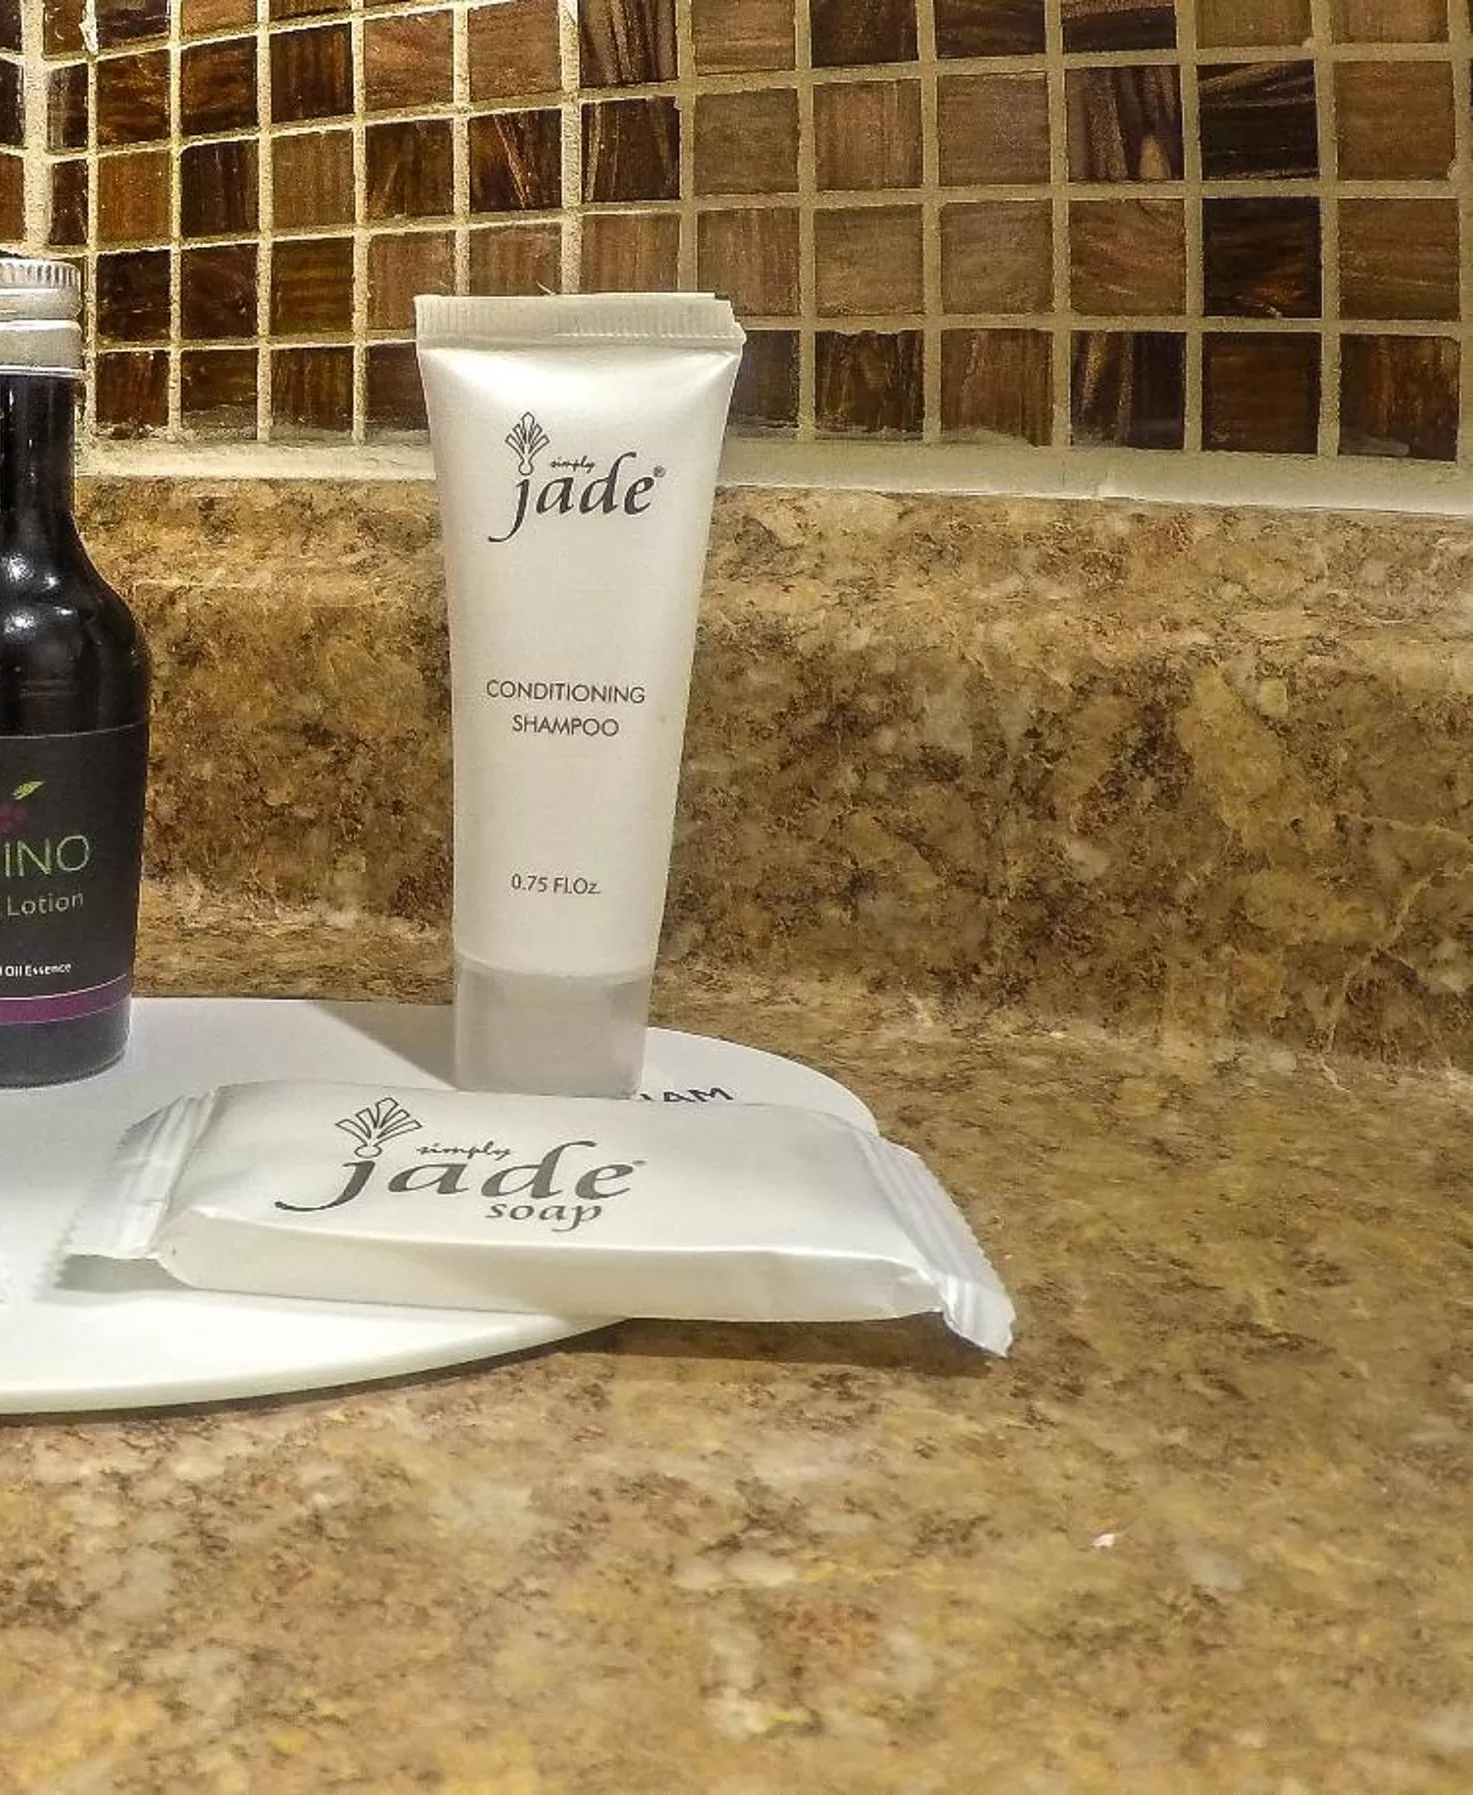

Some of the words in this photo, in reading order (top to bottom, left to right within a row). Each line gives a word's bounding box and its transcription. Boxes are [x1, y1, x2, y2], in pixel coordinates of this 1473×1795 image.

[549, 455, 595, 473] simply
[485, 679, 646, 704] CONDITIONING
[510, 714, 620, 737] SHAMPOO
[510, 873, 548, 893] 0.75
[6, 890, 84, 917] Lotion
[5, 964, 23, 978] Oil
[25, 962, 72, 977] Essence
[416, 1140, 512, 1160] simply
[485, 1201, 603, 1232] soap
